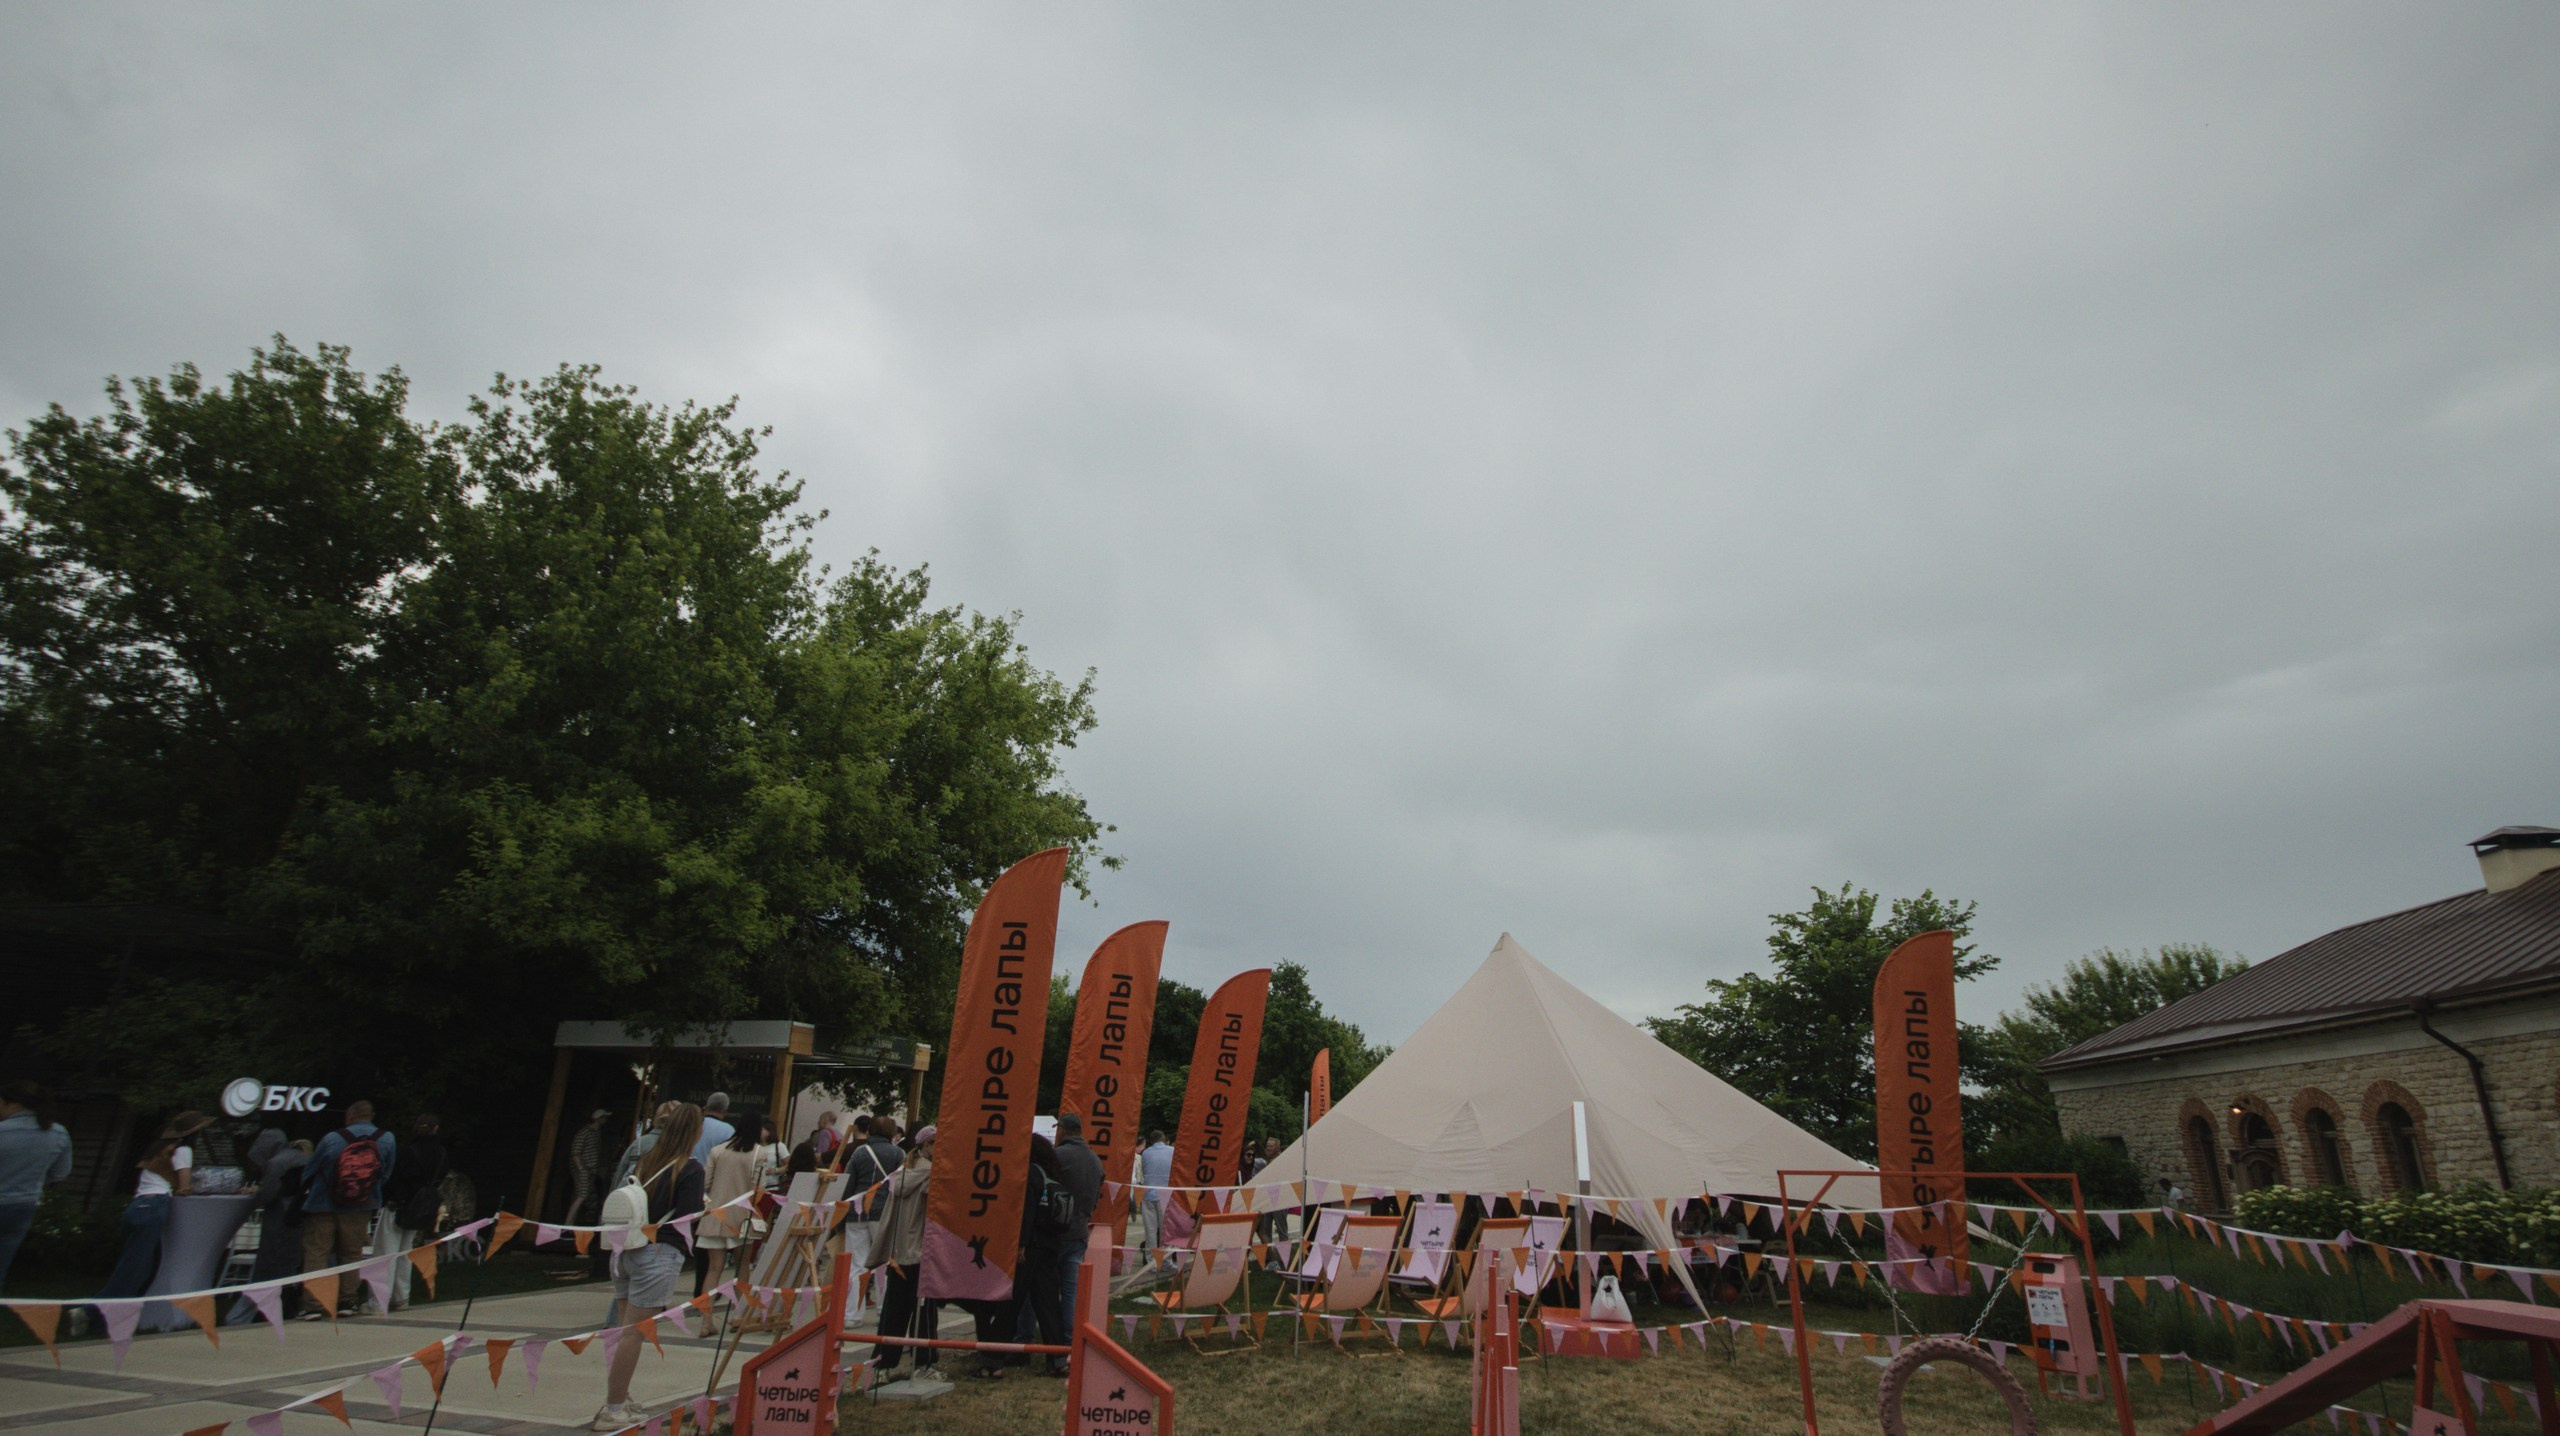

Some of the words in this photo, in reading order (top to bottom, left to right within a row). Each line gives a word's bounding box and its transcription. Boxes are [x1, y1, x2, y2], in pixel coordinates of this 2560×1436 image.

[991, 922, 1028, 1035] лапы
[1100, 974, 1133, 1067] лапы
[1215, 1013, 1243, 1087] лапы
[1904, 991, 1931, 1083] лапы
[261, 1084, 331, 1112] БКС
[969, 1046, 1014, 1217] четыре
[758, 1386, 820, 1403] четыре
[765, 1406, 809, 1423] лапы
[1081, 1406, 1151, 1425] четыре
